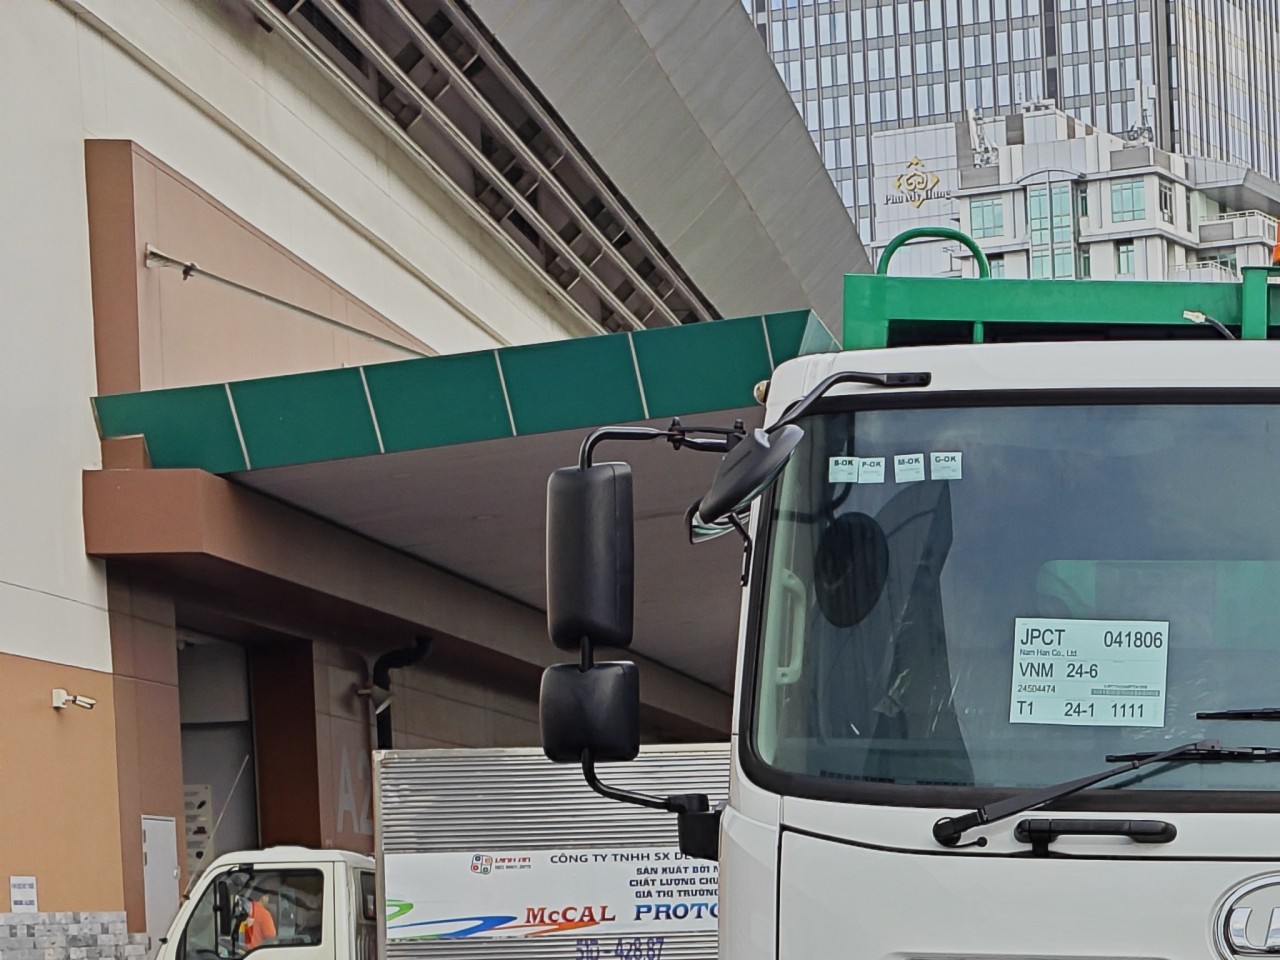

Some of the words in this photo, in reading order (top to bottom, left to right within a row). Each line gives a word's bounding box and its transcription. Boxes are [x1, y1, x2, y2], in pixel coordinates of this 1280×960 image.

[834, 459, 854, 467] B-OK
[1020, 628, 1066, 646] JPCT
[1103, 630, 1163, 648] 041806
[1019, 662, 1054, 678] VNM
[1066, 663, 1099, 679] 24-6
[1016, 700, 1034, 715] T1
[1063, 702, 1095, 717] 24-1
[1110, 703, 1145, 718] 1111
[550, 853, 588, 863] CÔNG
[592, 853, 608, 862] TY
[611, 852, 650, 862] TNHH
[654, 852, 670, 861] SX
[699, 877, 718, 885] CHU
[525, 905, 616, 925] McCAL
